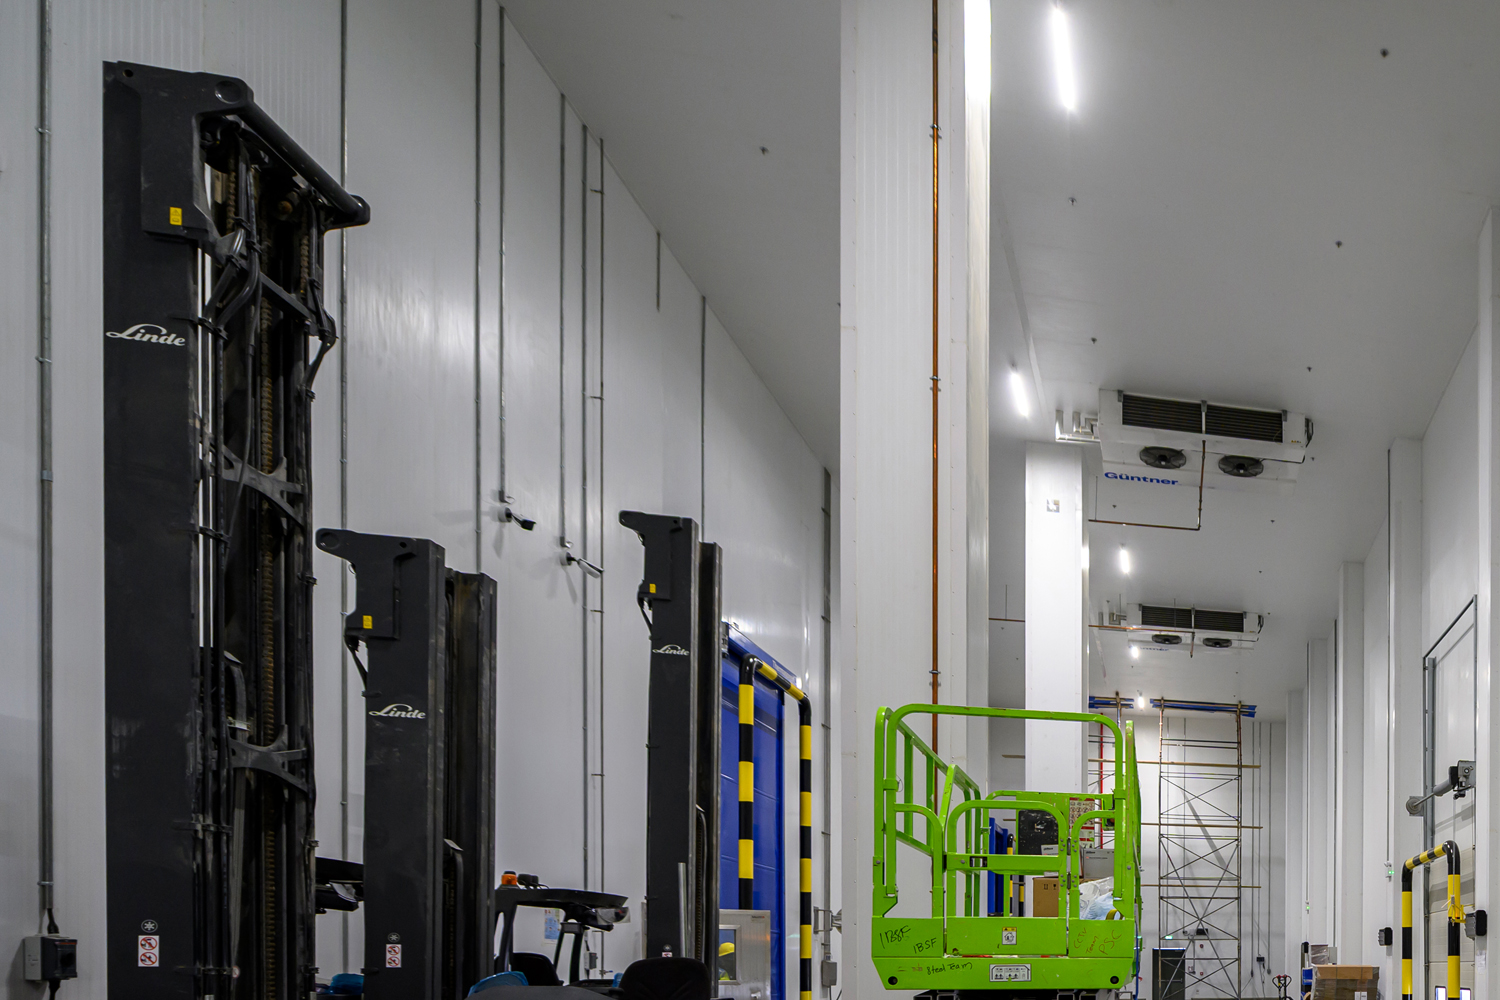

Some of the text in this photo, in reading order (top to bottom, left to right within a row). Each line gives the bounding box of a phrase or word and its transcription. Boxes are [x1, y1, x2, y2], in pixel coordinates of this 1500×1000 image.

[105, 323, 186, 346] Linde
[1104, 471, 1179, 486] Güntner
[652, 644, 690, 656] Linde
[368, 703, 426, 719] Linde
